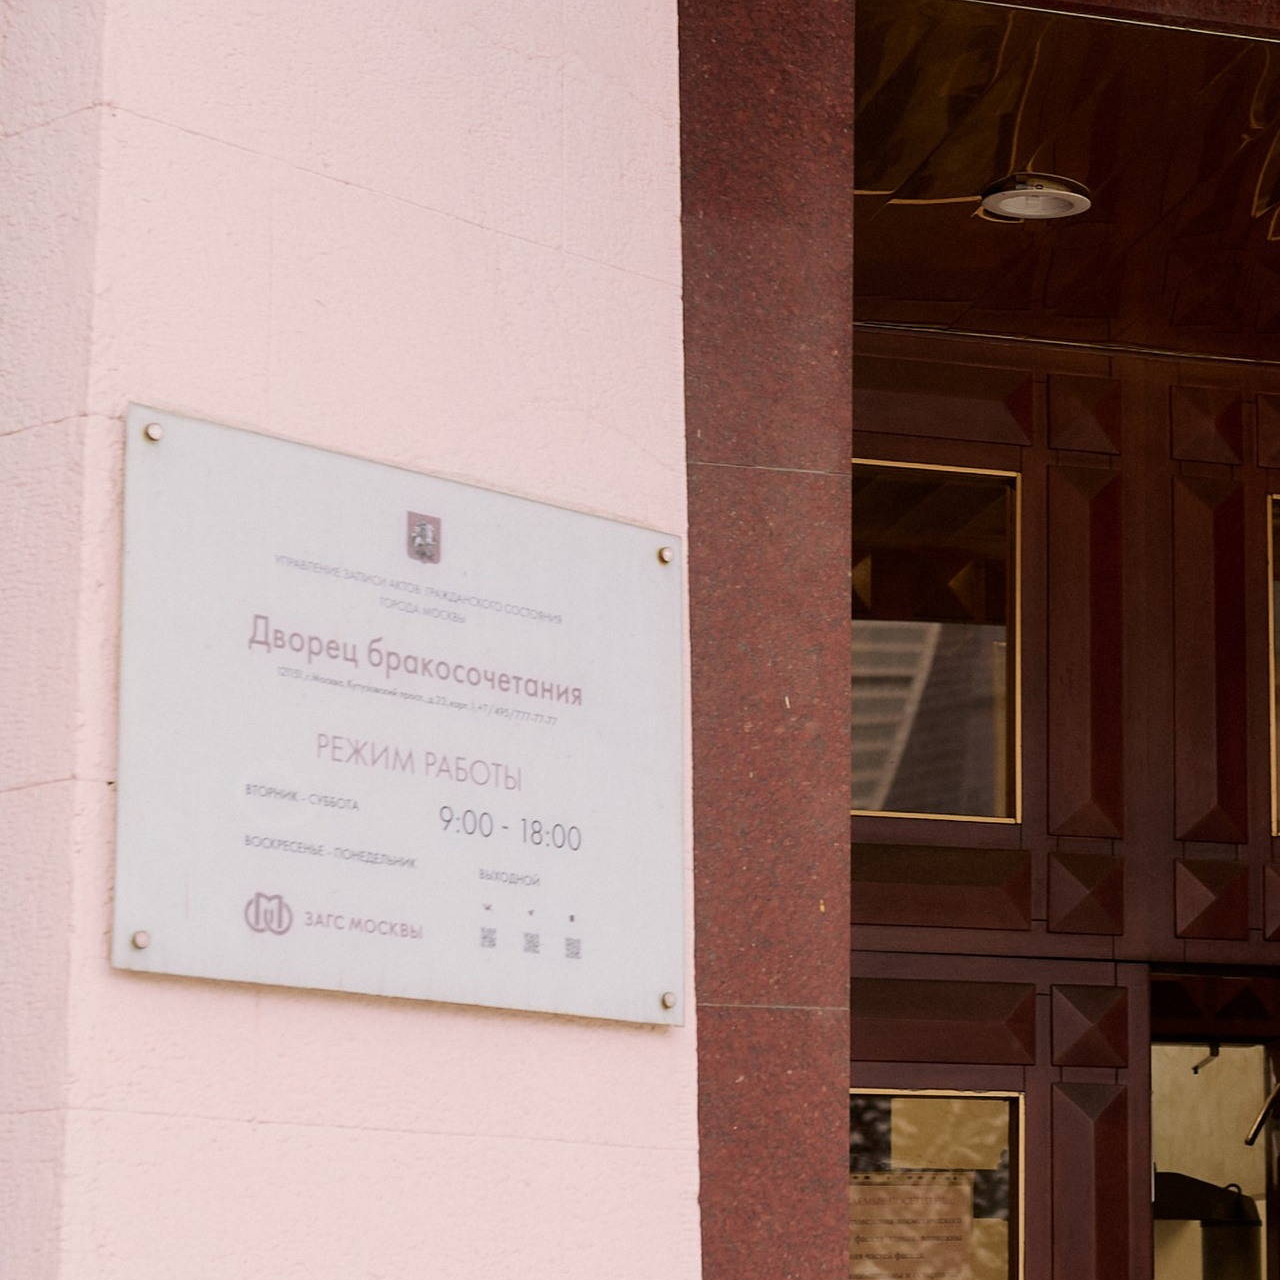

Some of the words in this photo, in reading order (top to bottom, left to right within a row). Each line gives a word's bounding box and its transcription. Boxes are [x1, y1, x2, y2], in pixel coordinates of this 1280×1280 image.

[422, 606, 465, 624] МОСКВЫ
[249, 614, 358, 667] Дворец
[368, 637, 582, 706] бракосочетания
[316, 733, 415, 775] РЕЖИМ
[425, 752, 521, 791] РАБОТЫ
[245, 783, 298, 803] ВТОРНИК
[309, 793, 359, 811] СУББОТА
[439, 805, 493, 838] 9:00
[521, 818, 581, 851] 18:00
[245, 834, 325, 857] ВОСКРЕСЕНЬЕ
[334, 847, 418, 868] ПОНЕДЕЛЬНИК
[479, 868, 540, 887] ВЫХОДНОЙ
[304, 911, 344, 930] ЗАГС
[349, 917, 423, 939] МОСКВЫ
